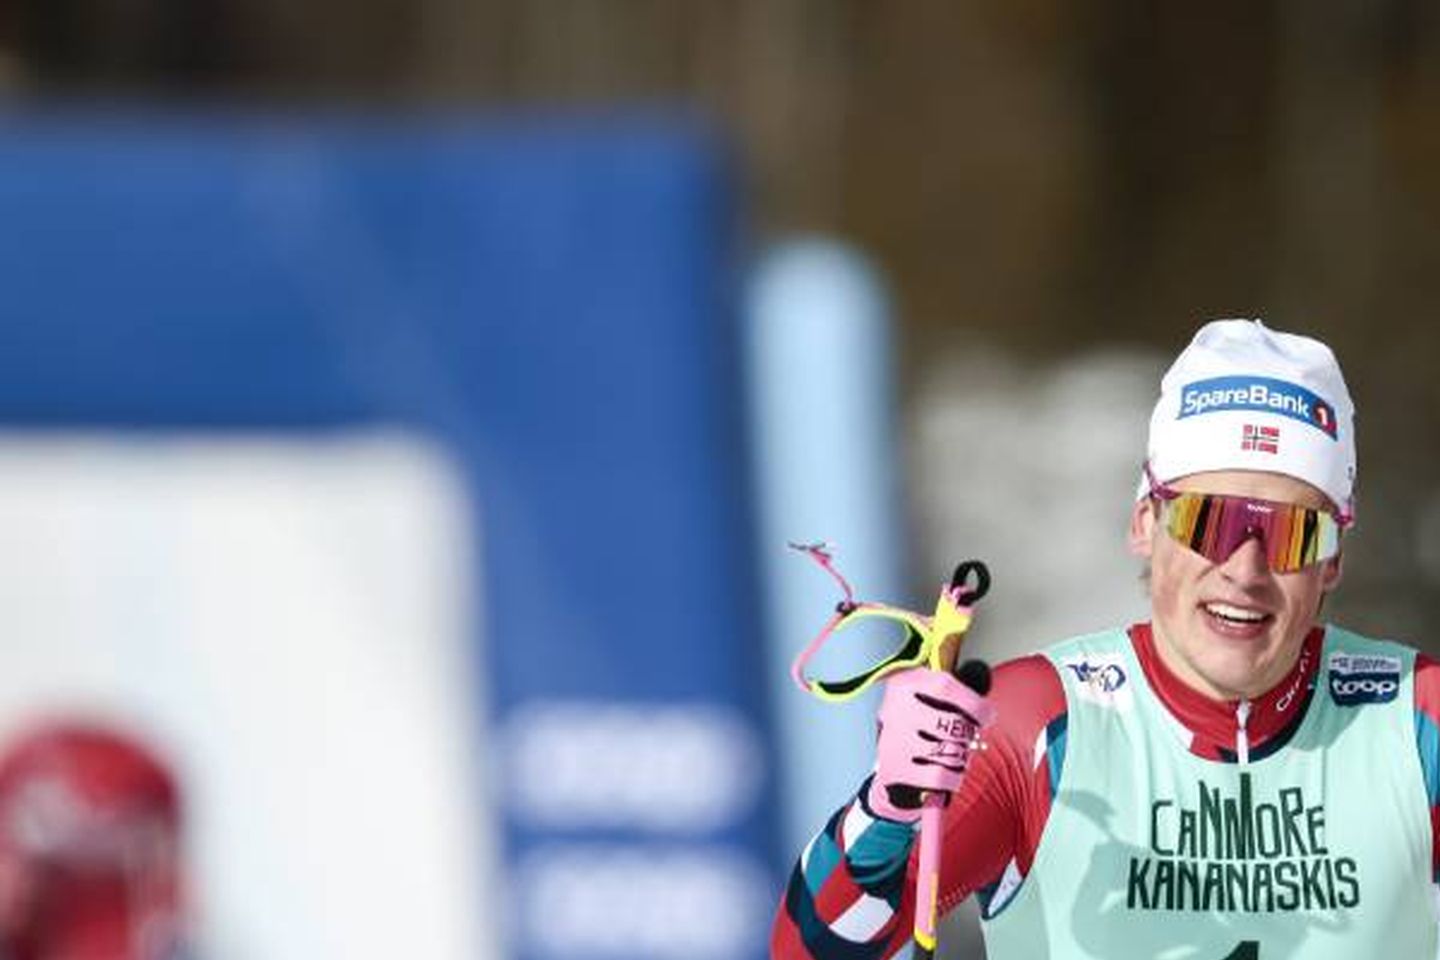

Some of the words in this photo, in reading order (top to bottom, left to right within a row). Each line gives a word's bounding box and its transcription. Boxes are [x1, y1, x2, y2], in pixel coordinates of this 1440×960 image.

[1182, 385, 1310, 419] SpareBank
[1316, 404, 1329, 426] 1
[1126, 857, 1360, 912] KANANASKIS
